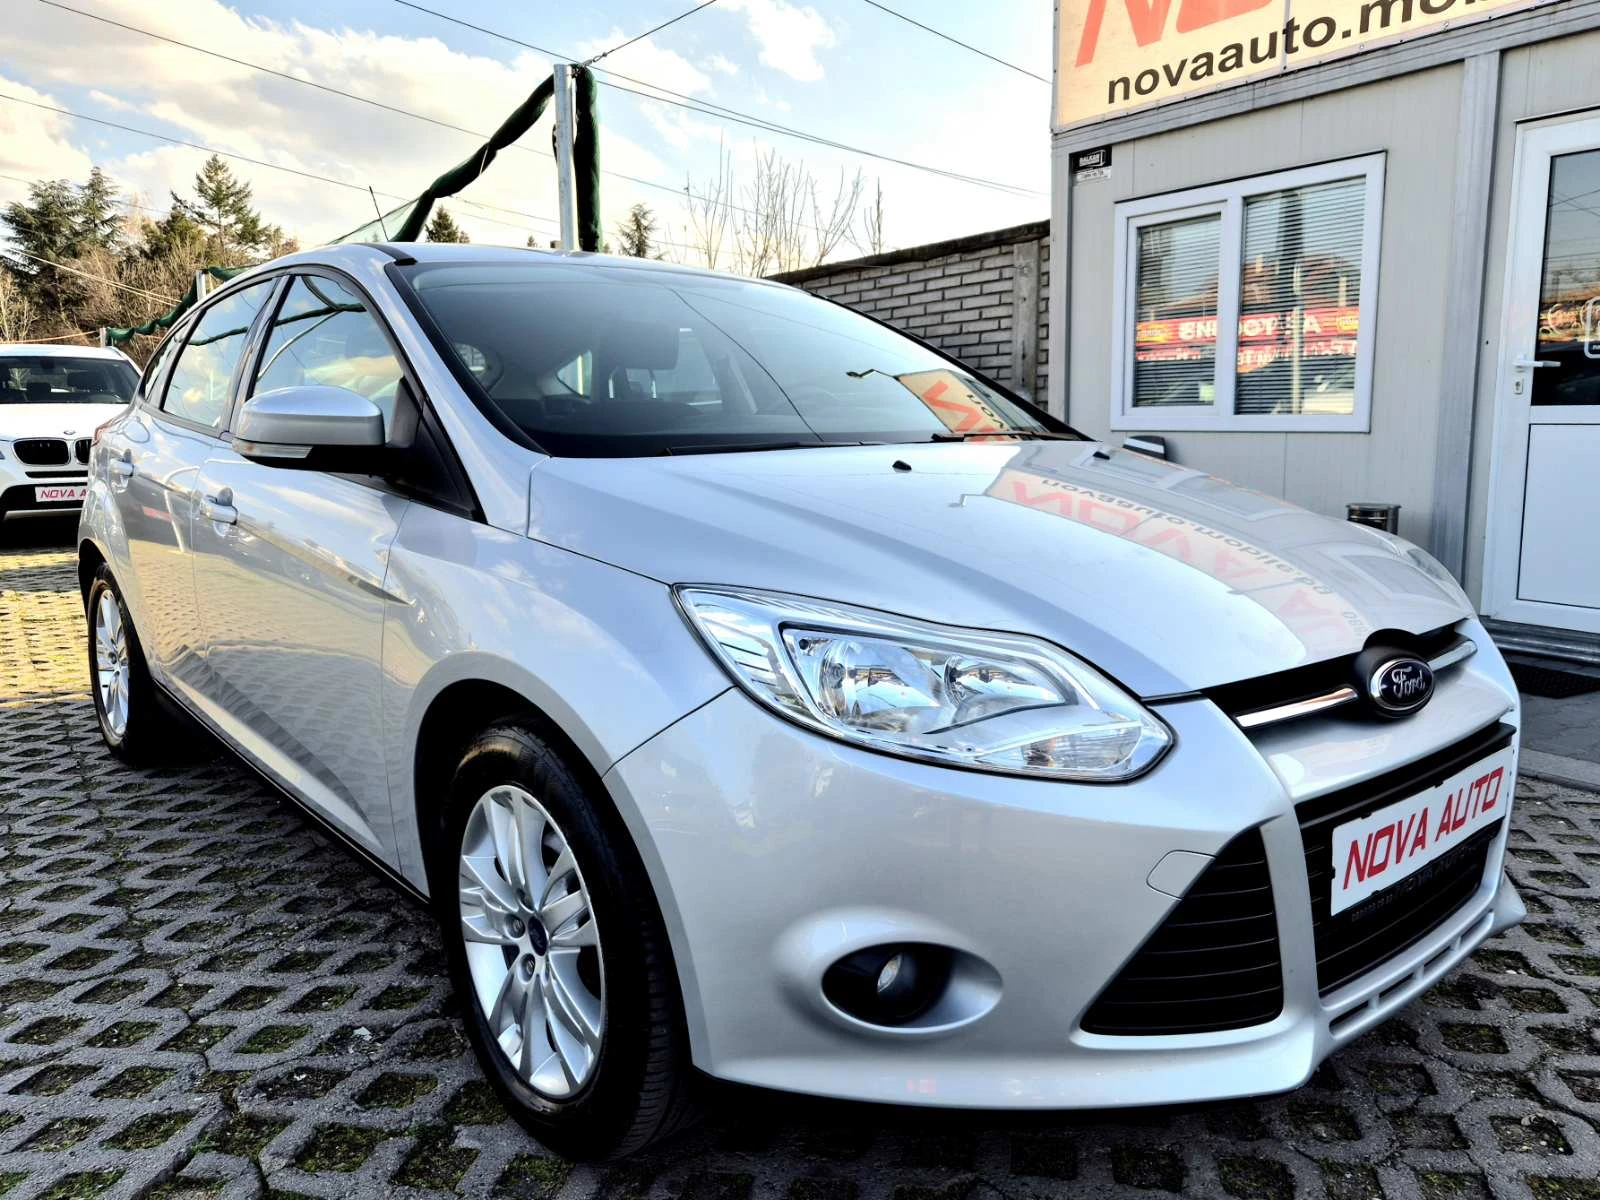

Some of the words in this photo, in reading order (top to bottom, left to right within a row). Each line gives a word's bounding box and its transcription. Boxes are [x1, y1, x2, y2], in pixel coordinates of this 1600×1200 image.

[41, 489, 75, 498] NOVA
[1392, 666, 1425, 698] Ford
[1343, 807, 1428, 890] NOVA
[1435, 766, 1504, 842] AUTO
